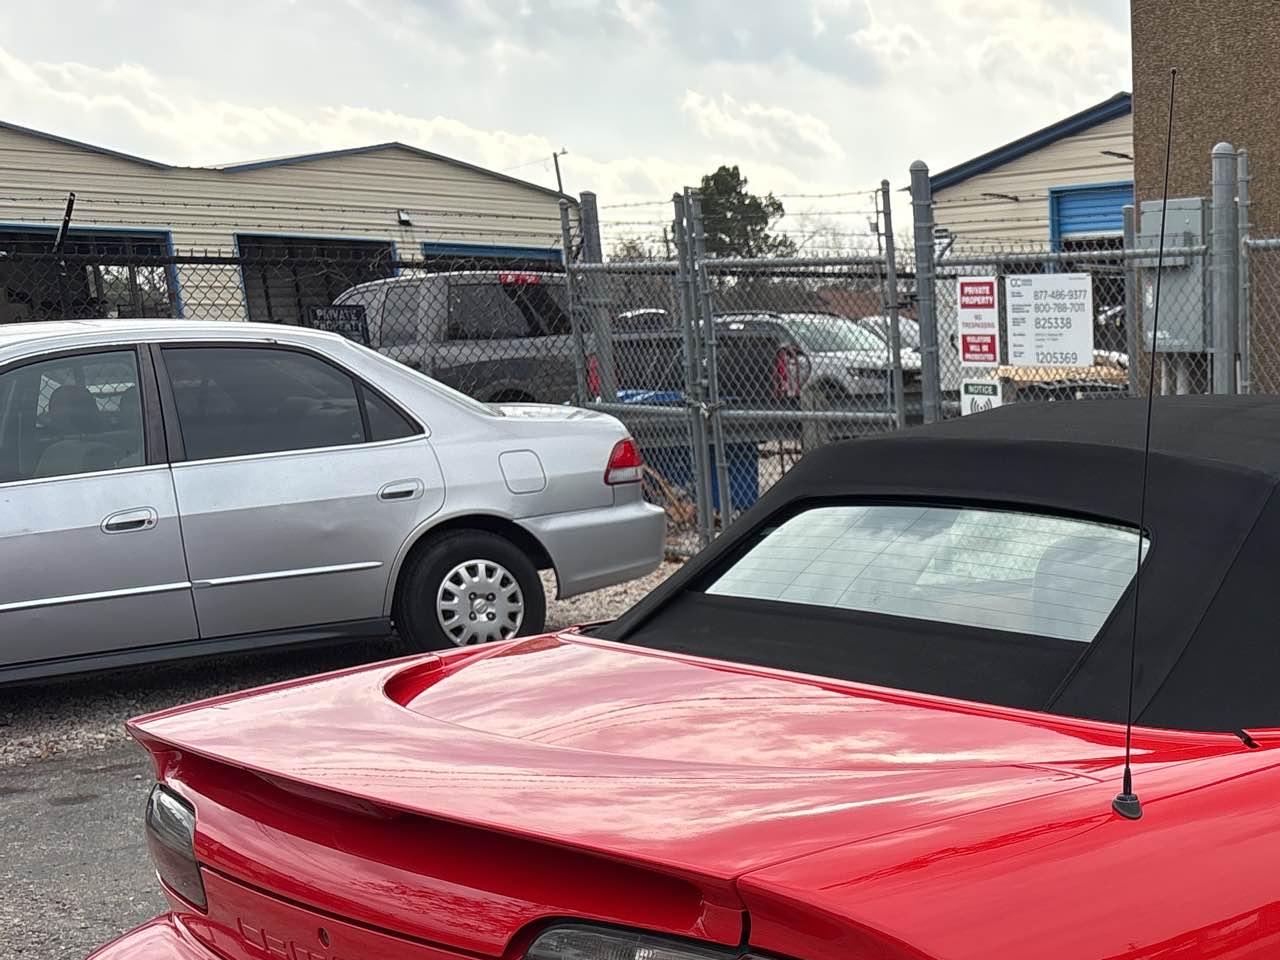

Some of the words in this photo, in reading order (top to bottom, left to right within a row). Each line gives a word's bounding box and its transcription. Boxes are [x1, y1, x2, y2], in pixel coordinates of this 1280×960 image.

[963, 286, 990, 295] PRIVATE
[1033, 289, 1088, 301] 877-486-9377
[961, 296, 994, 305] PROPERTY
[1034, 303, 1086, 313] 800-788-7011
[316, 309, 358, 320] PRIVATE
[1034, 317, 1073, 330] 825338
[1035, 351, 1078, 365] 1205369
[967, 386, 993, 395] NOTICE
